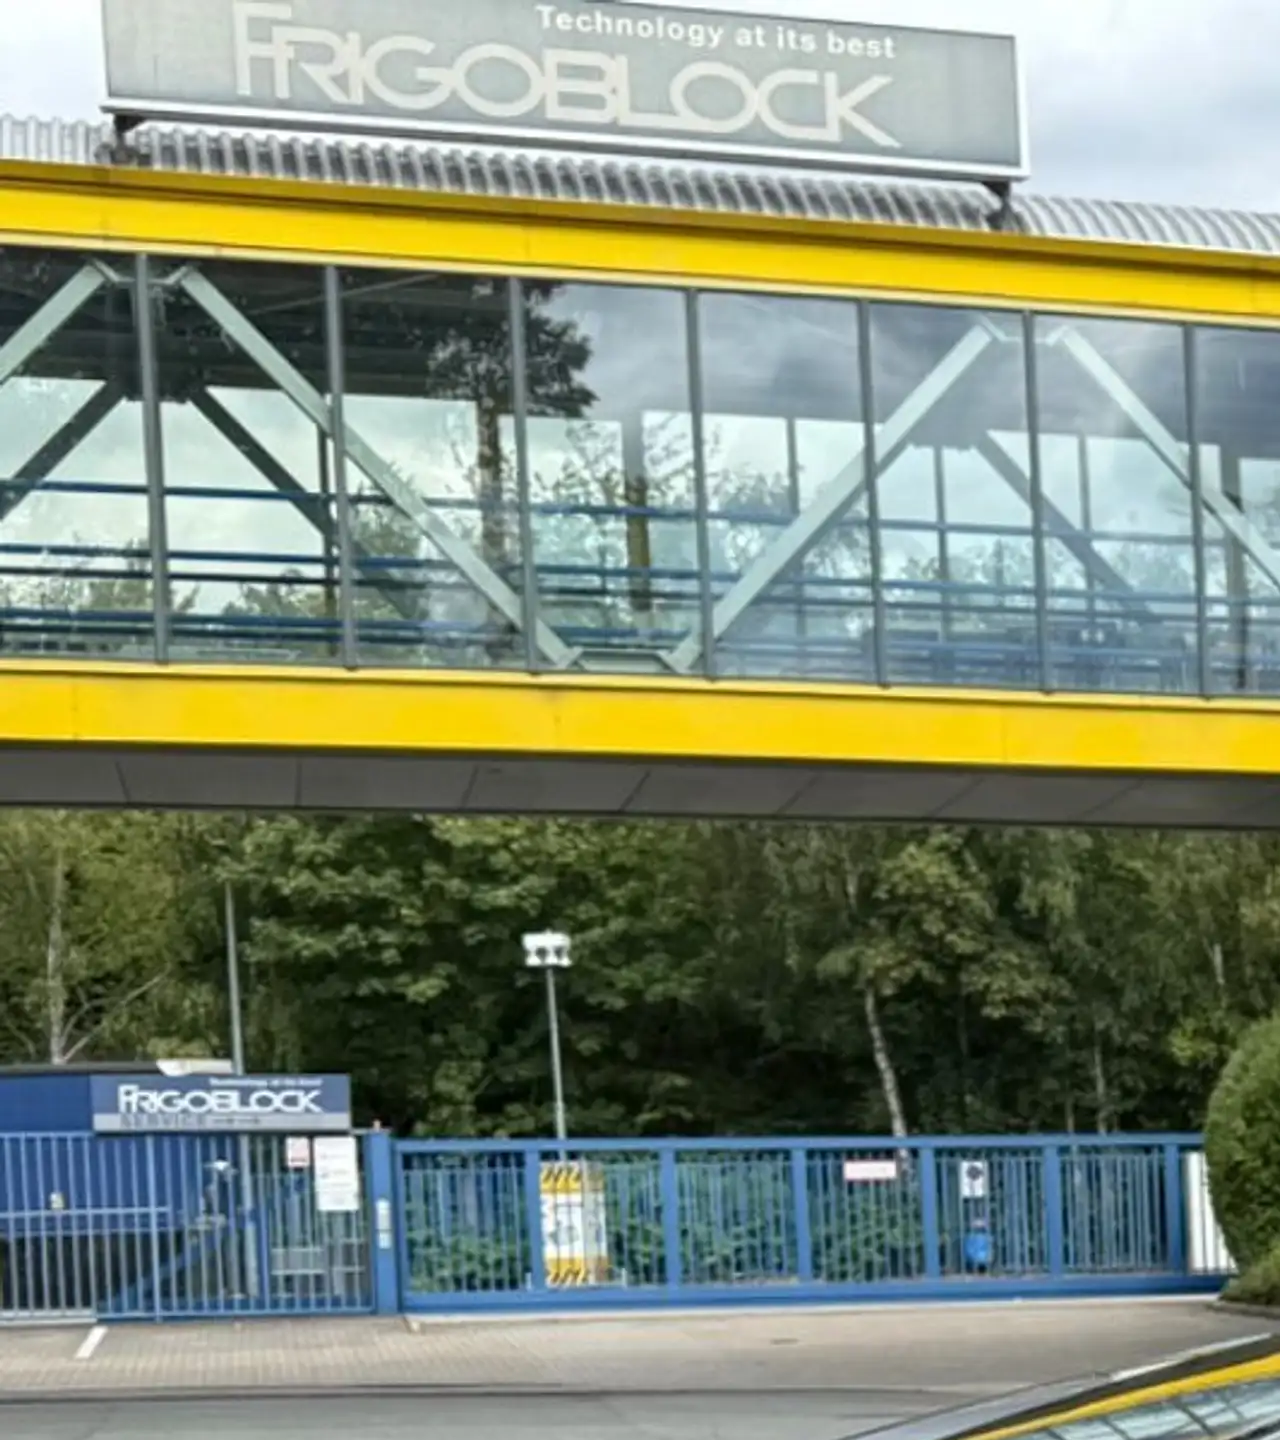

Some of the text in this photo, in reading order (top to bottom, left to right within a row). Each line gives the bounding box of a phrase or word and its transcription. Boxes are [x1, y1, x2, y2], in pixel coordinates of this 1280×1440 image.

[537, 5, 898, 60] Technology at its best
[234, 1, 901, 148] FRIGOBLOCK
[117, 1084, 323, 1114] FRIGOBLOCK
